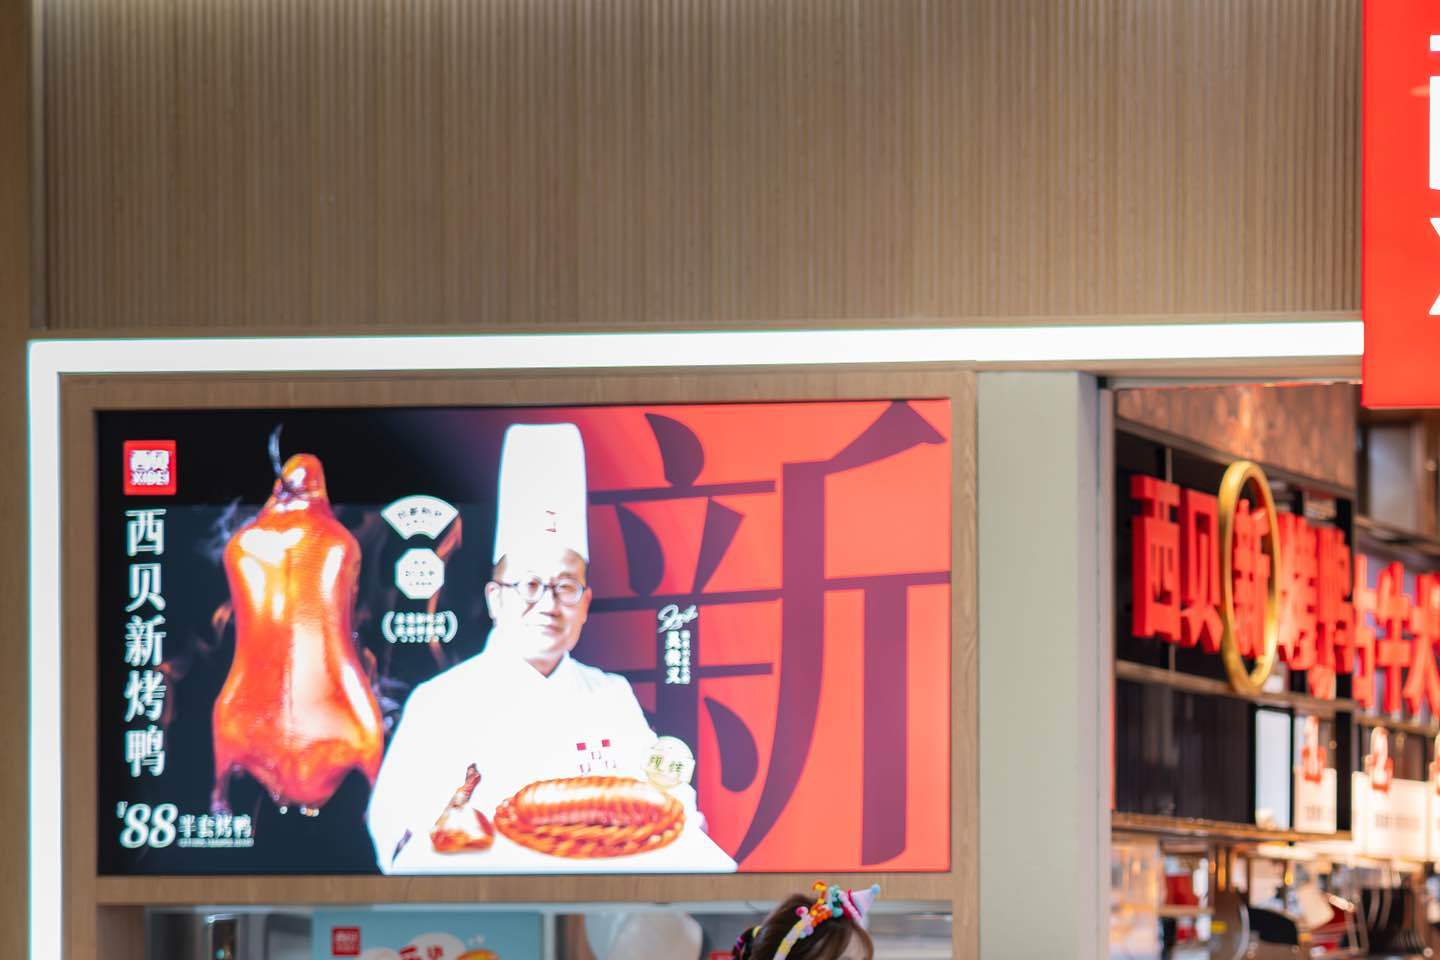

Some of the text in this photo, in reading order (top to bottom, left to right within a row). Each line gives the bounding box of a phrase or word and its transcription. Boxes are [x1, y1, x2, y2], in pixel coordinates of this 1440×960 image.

[123, 508, 167, 777] 西贝新烤鸭
